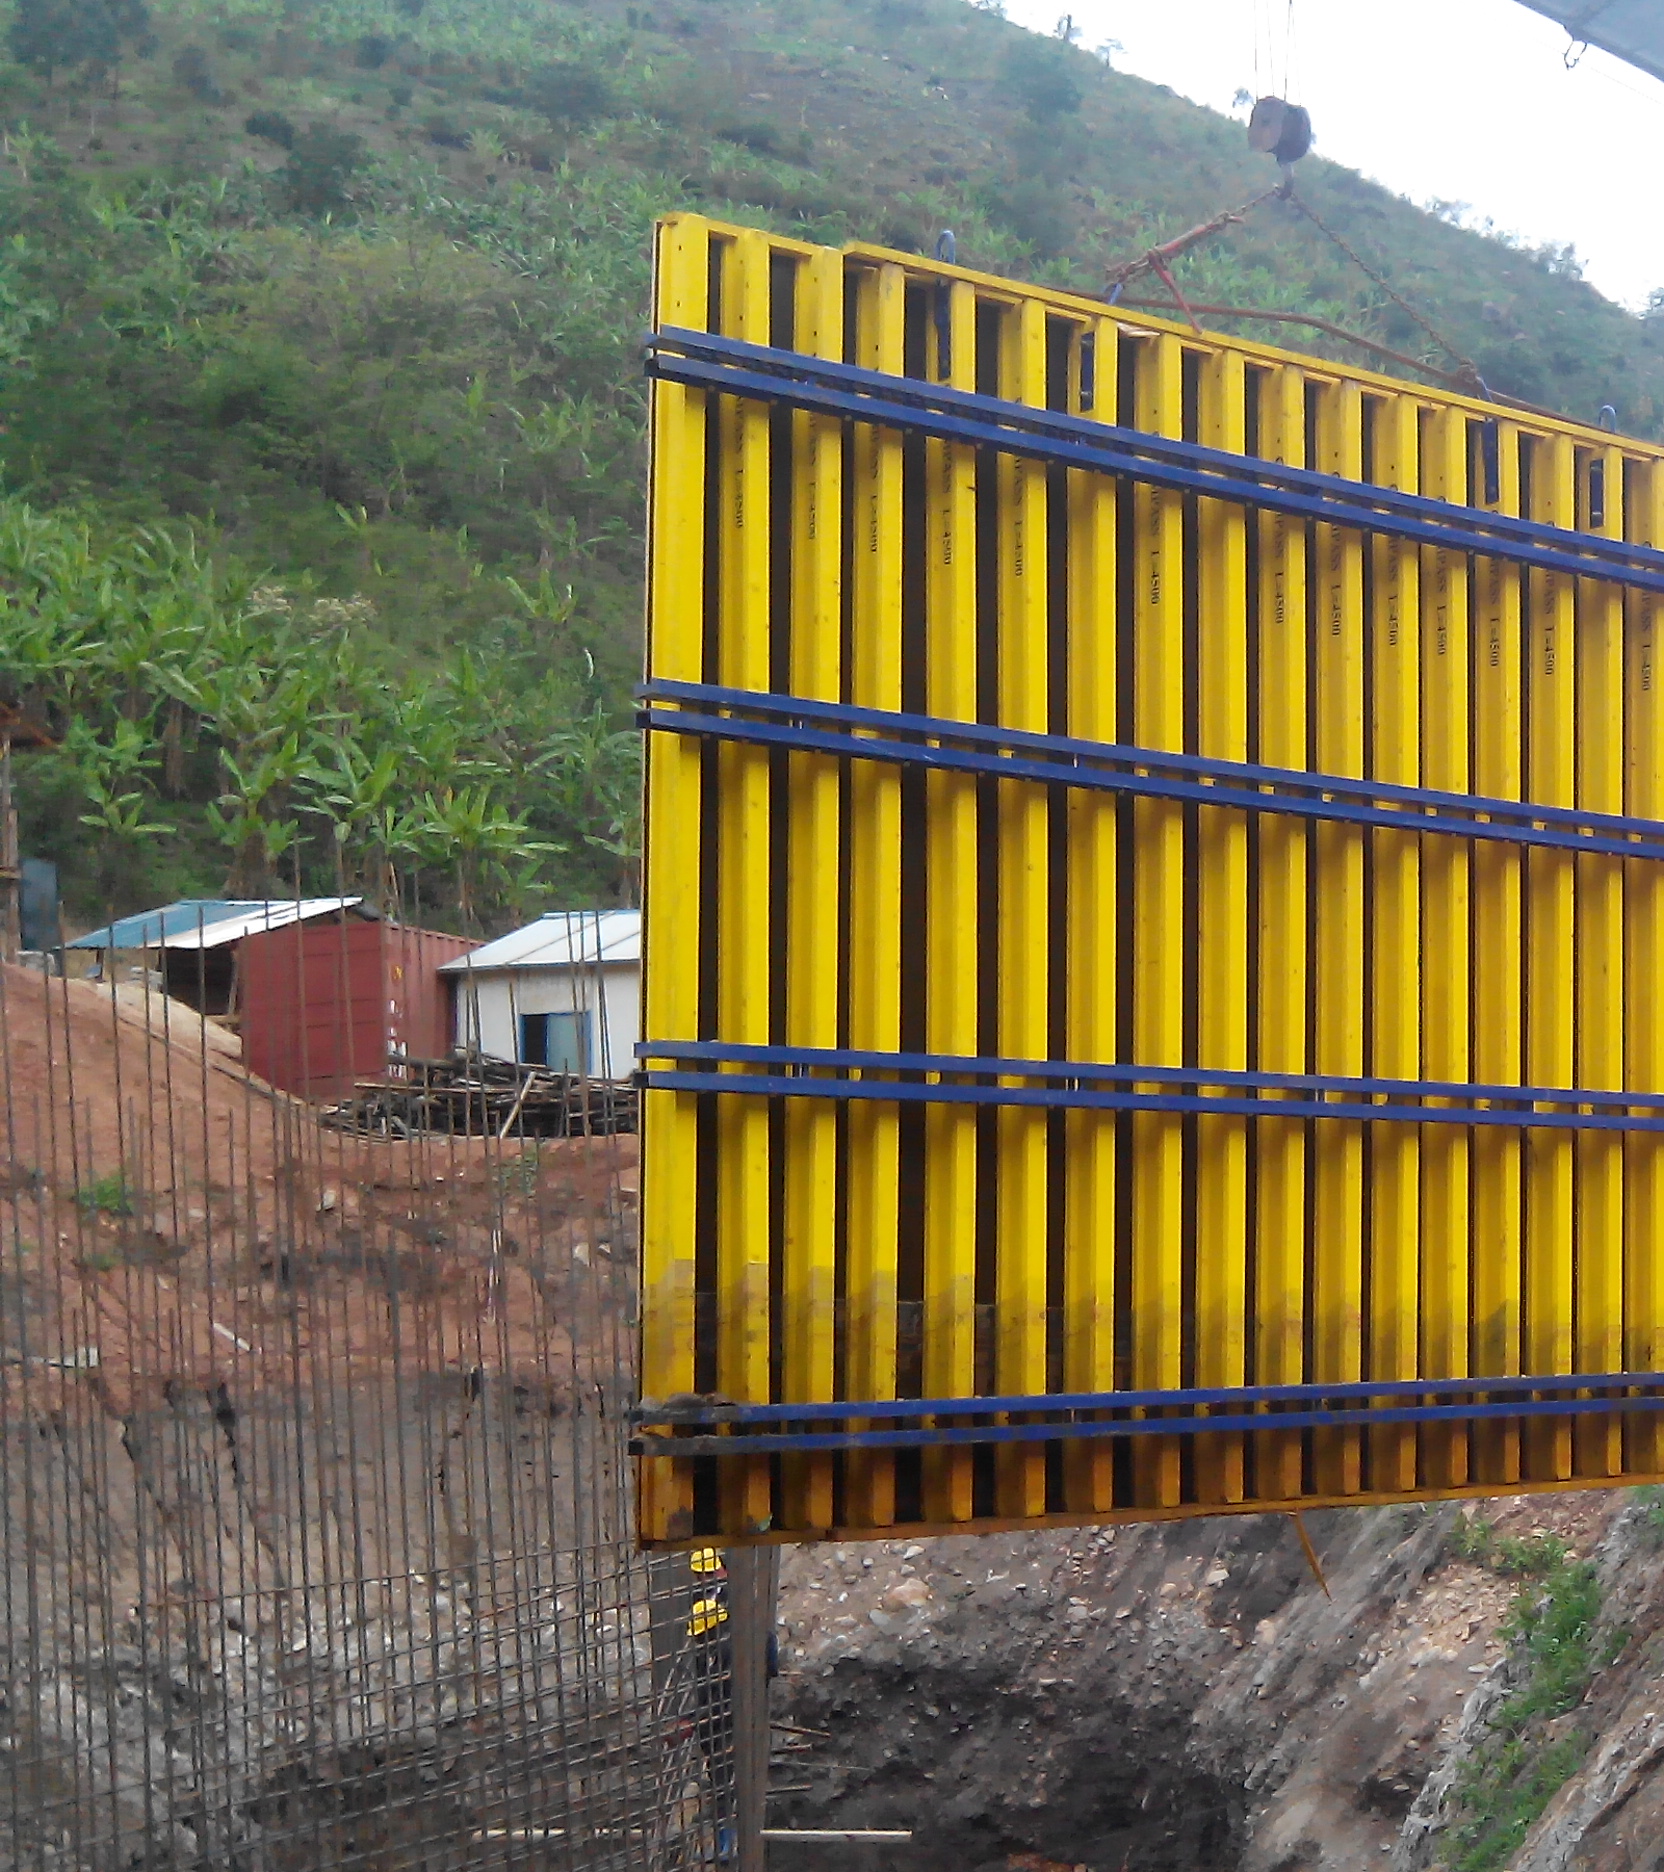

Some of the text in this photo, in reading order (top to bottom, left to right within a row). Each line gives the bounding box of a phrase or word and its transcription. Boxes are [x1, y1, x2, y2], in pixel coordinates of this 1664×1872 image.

[1276, 572, 1284, 624] L=4500
[1331, 585, 1340, 636] L=4500
[1388, 595, 1398, 646] L=4500
[1437, 605, 1446, 655] L=4500
[1490, 617, 1499, 667] L=4500
[1545, 627, 1554, 675] L=4500
[1642, 644, 1651, 691] L=4500
